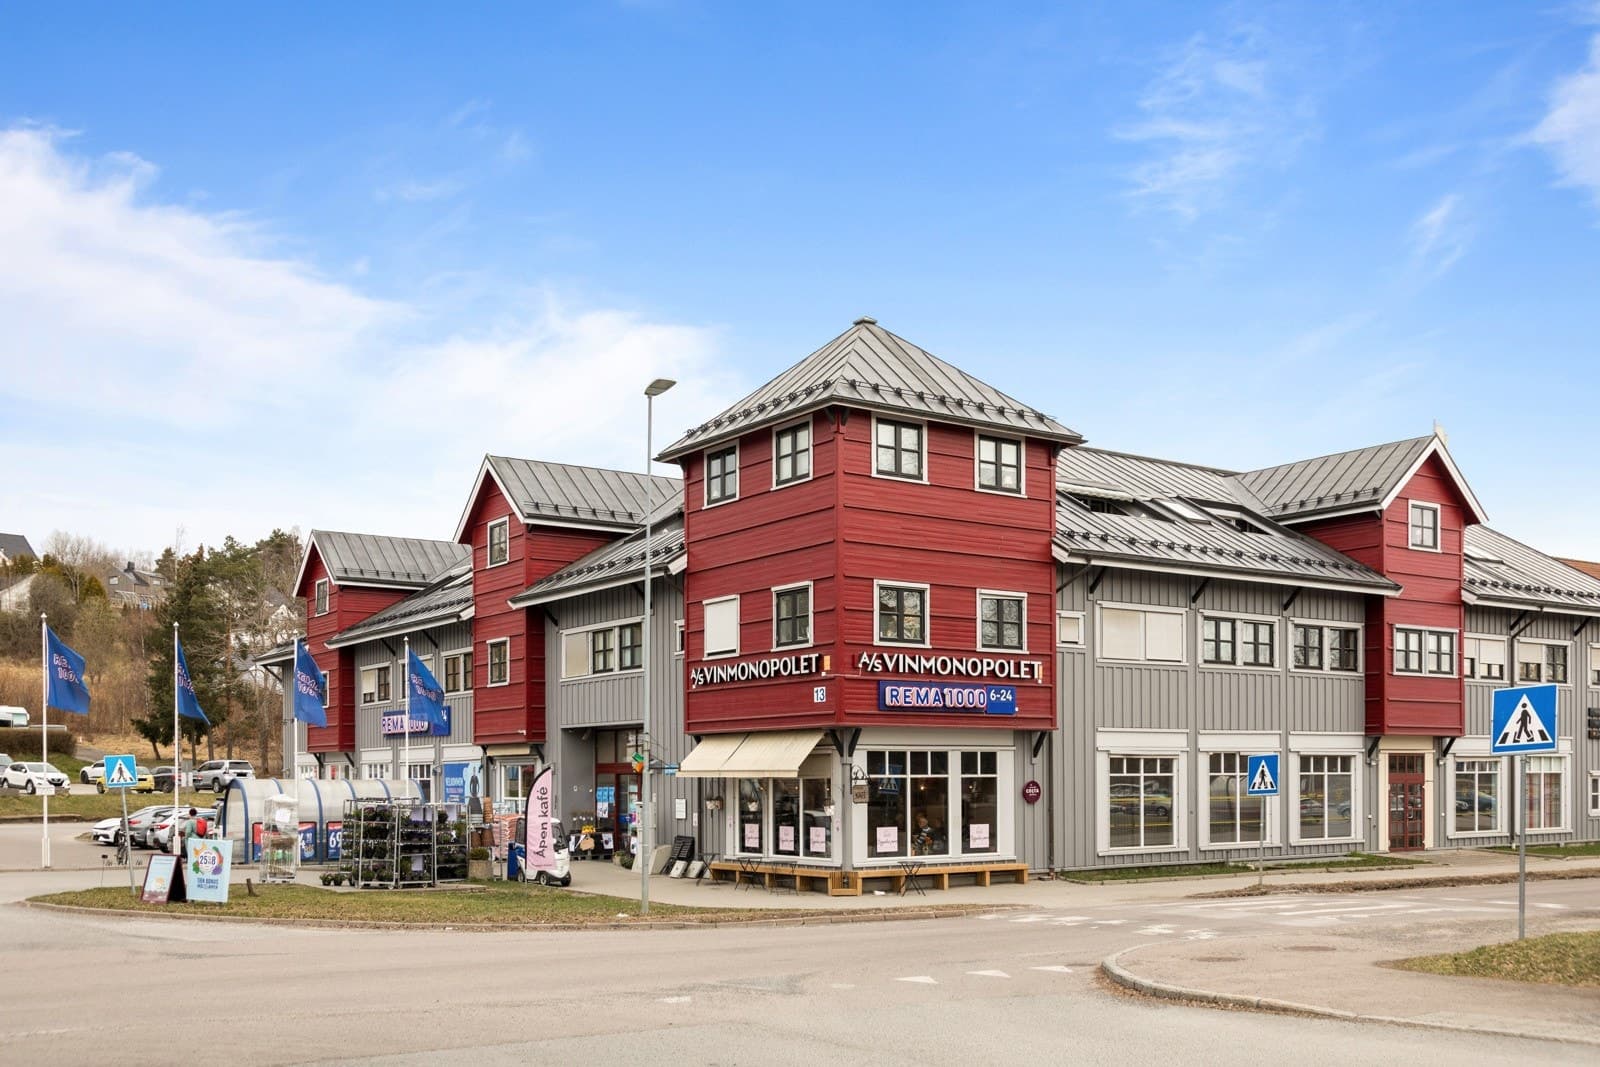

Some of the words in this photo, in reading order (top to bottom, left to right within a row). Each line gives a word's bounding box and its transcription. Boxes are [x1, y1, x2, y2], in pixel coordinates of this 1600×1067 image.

[703, 653, 819, 684] VINMONOPOLET
[883, 653, 1042, 679] VINMONOPOLET
[815, 688, 825, 702] 13
[885, 686, 943, 707] REMA
[943, 687, 987, 708] 1000
[990, 689, 1012, 701] 6-24
[382, 715, 405, 734] REMA
[536, 786, 549, 818] kafé
[533, 821, 549, 858] Åpen
